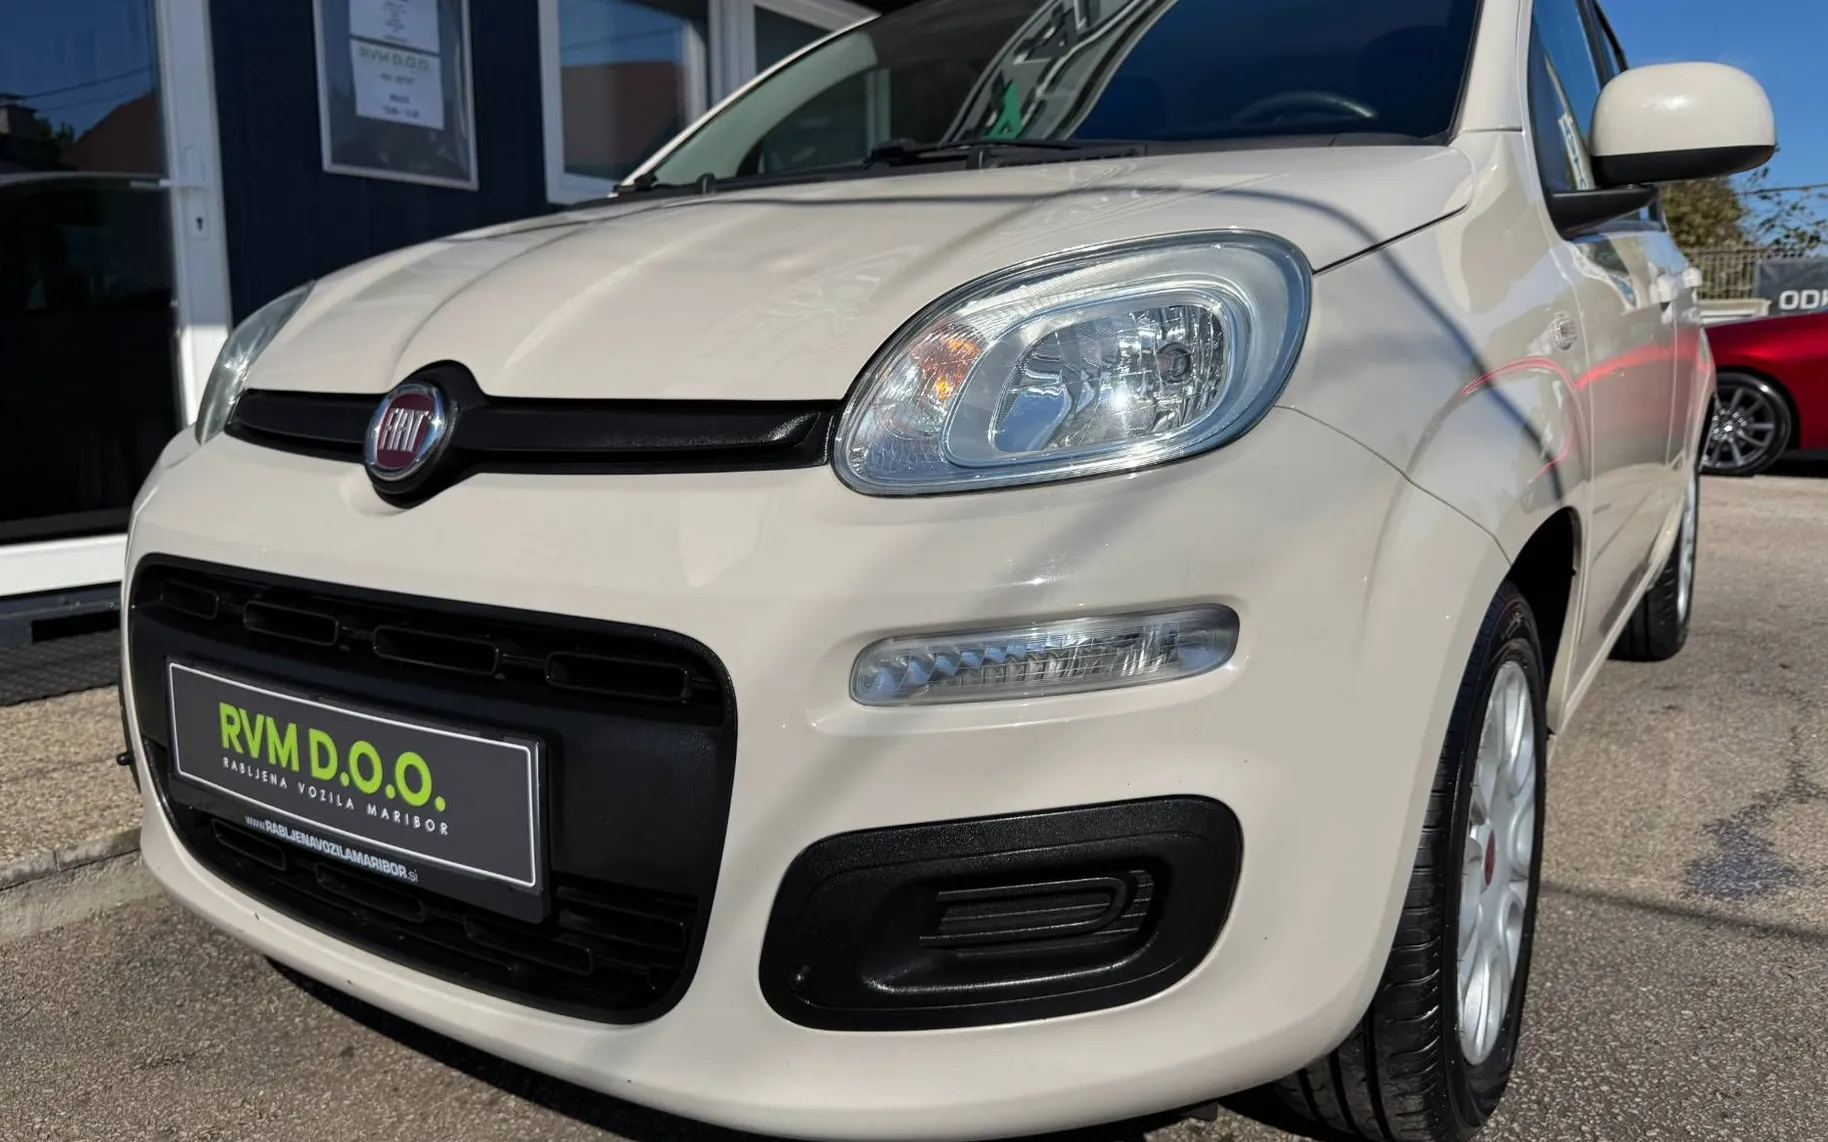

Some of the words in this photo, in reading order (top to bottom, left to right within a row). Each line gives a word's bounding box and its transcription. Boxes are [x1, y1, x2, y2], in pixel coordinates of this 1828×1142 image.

[378, 407, 431, 452] FIAT
[218, 701, 299, 772] RVM
[309, 728, 447, 813] D.O.O.
[222, 757, 288, 788] RABLJENA
[297, 782, 355, 810] VOZILA
[367, 804, 449, 836] MARIBOR
